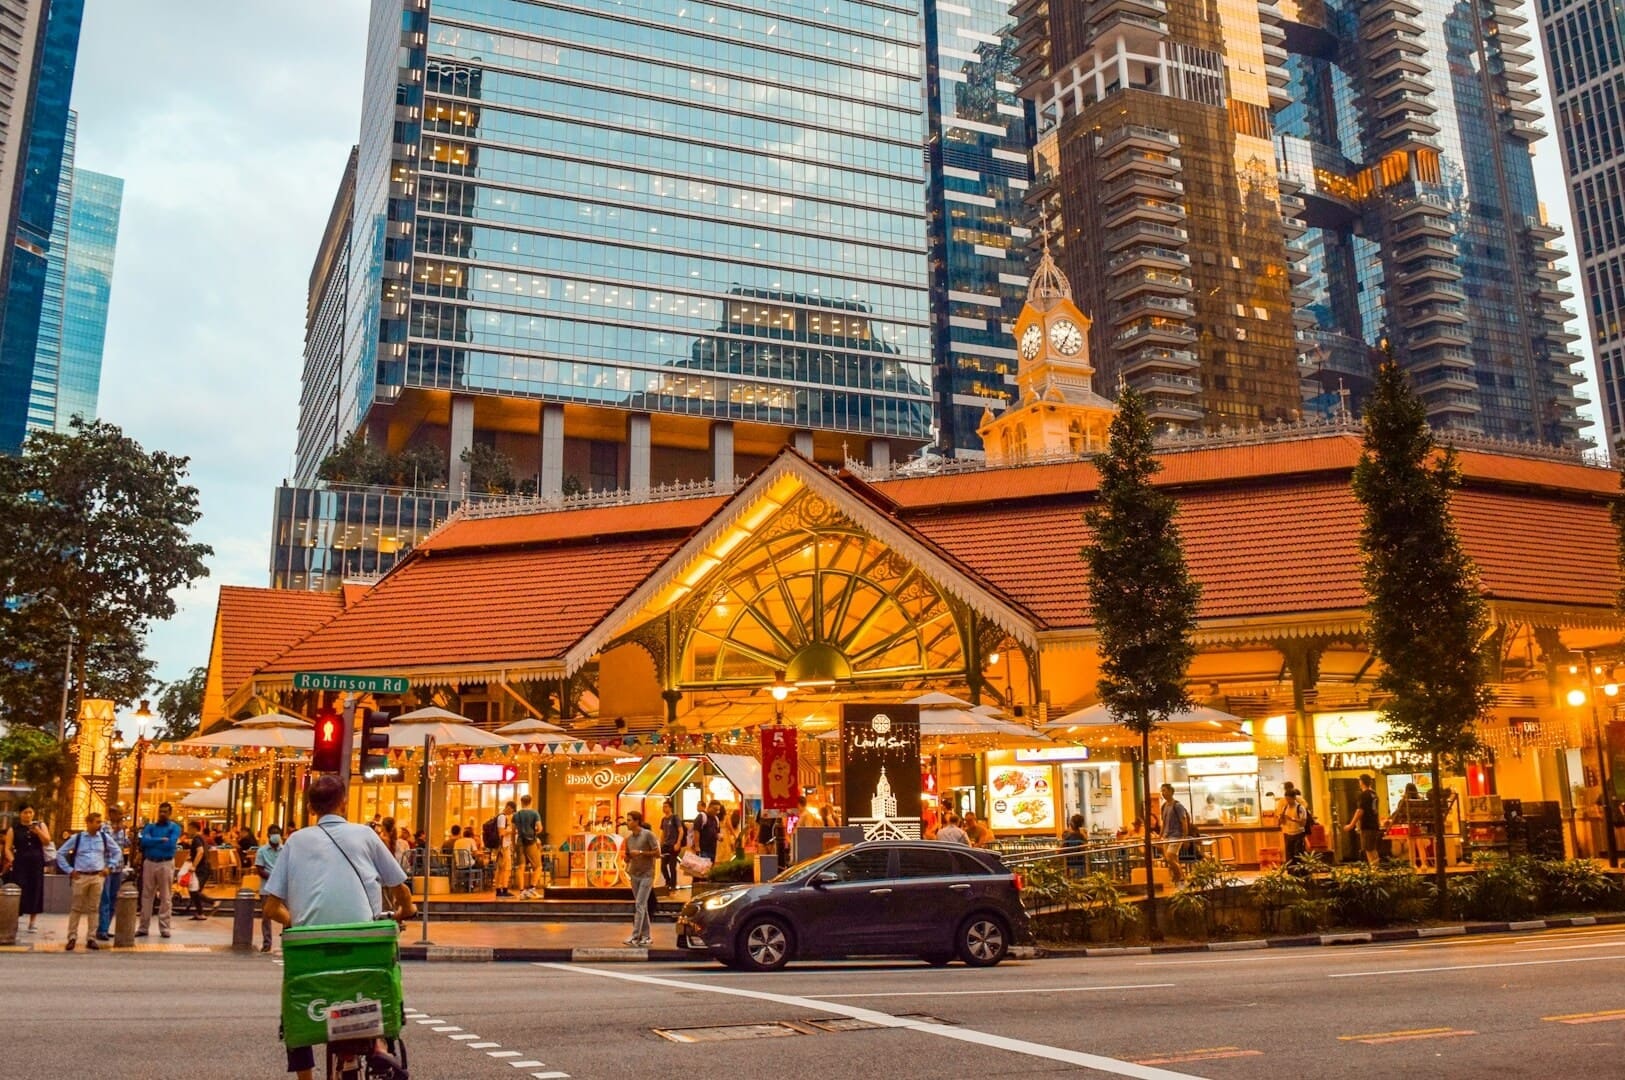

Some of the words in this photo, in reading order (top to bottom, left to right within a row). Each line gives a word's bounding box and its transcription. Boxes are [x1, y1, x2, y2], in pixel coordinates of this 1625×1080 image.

[301, 674, 376, 690] Robinson
[383, 678, 402, 691] Rd
[774, 732, 785, 743] 5
[1342, 753, 1393, 769] Mango
